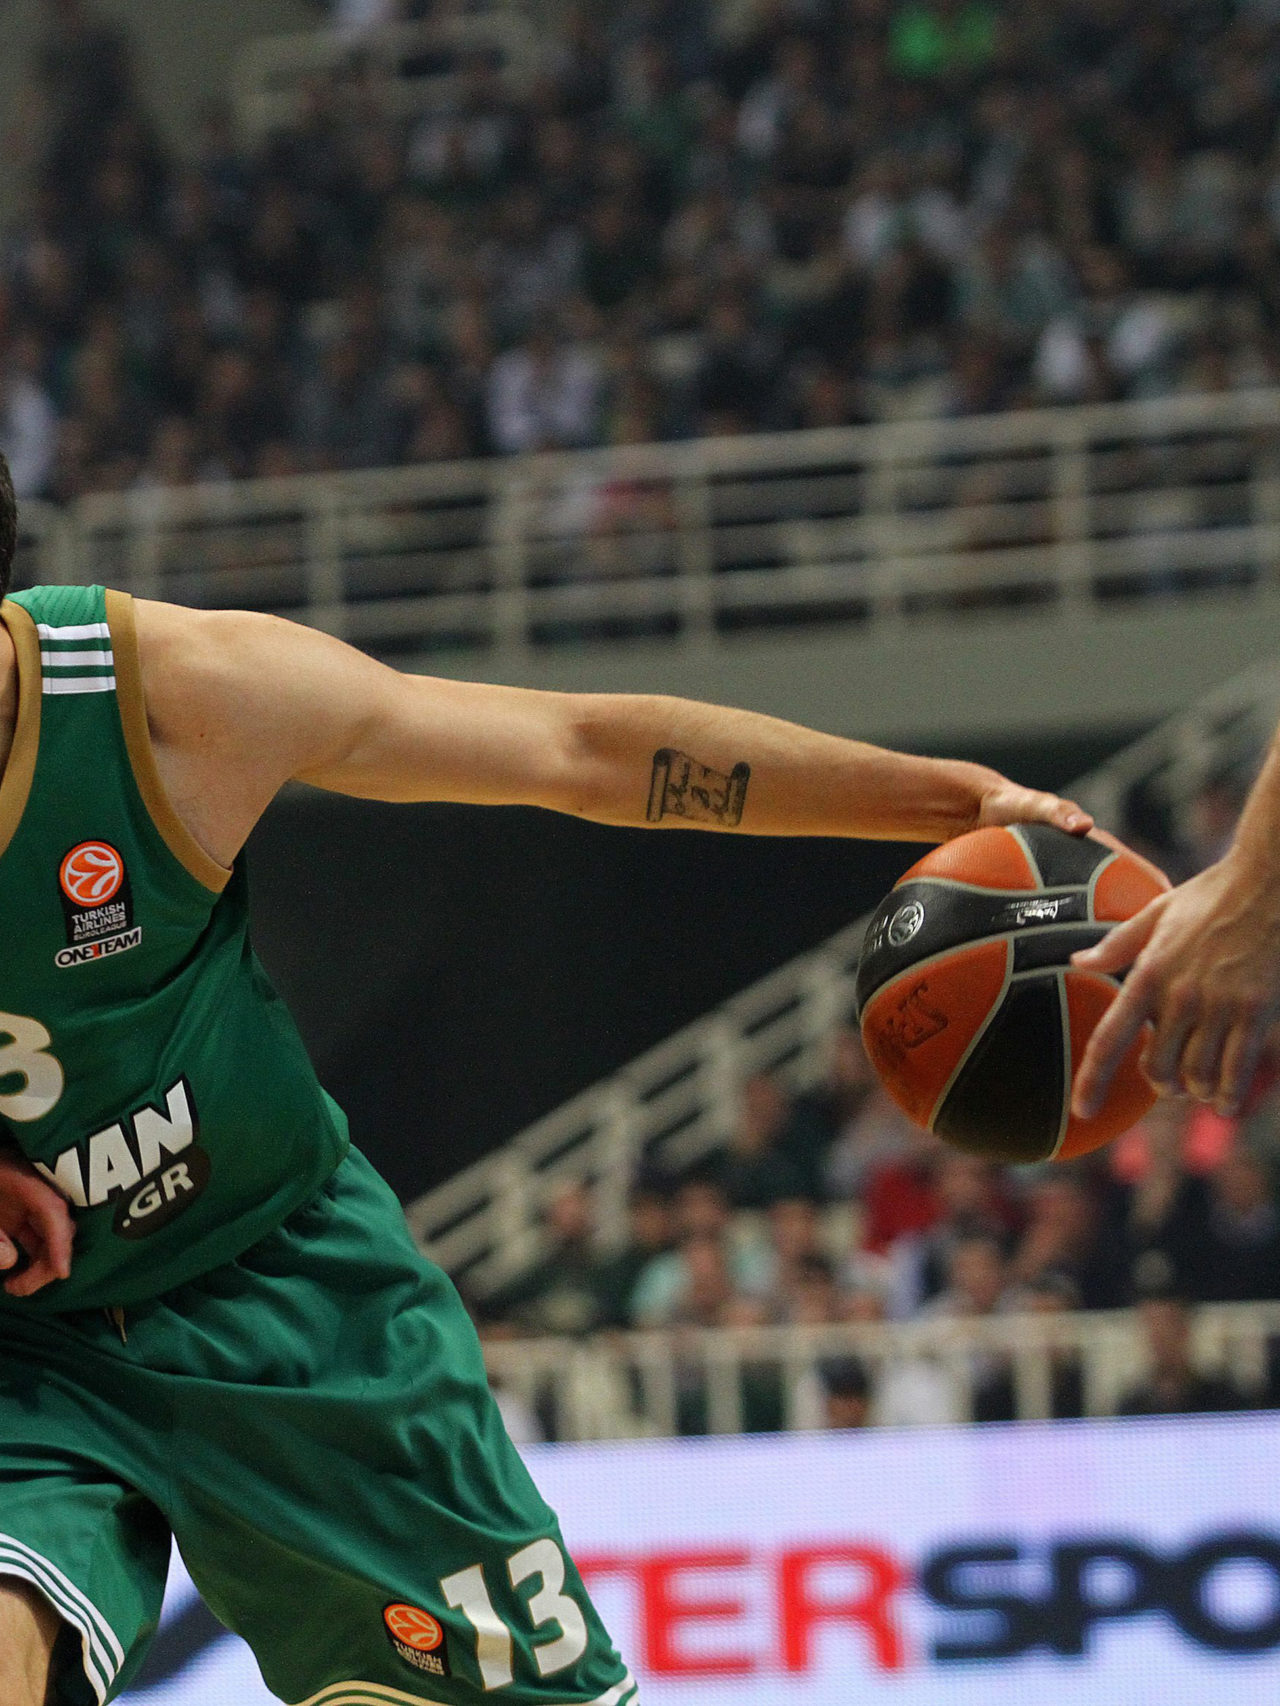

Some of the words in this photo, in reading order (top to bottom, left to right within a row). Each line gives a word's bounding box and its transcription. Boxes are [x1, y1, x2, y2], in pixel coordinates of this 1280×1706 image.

[72, 902, 126, 924] TURKISH
[73, 911, 127, 934] AIRLINES
[122, 1161, 195, 1229] .GR
[439, 1536, 589, 1693] 13
